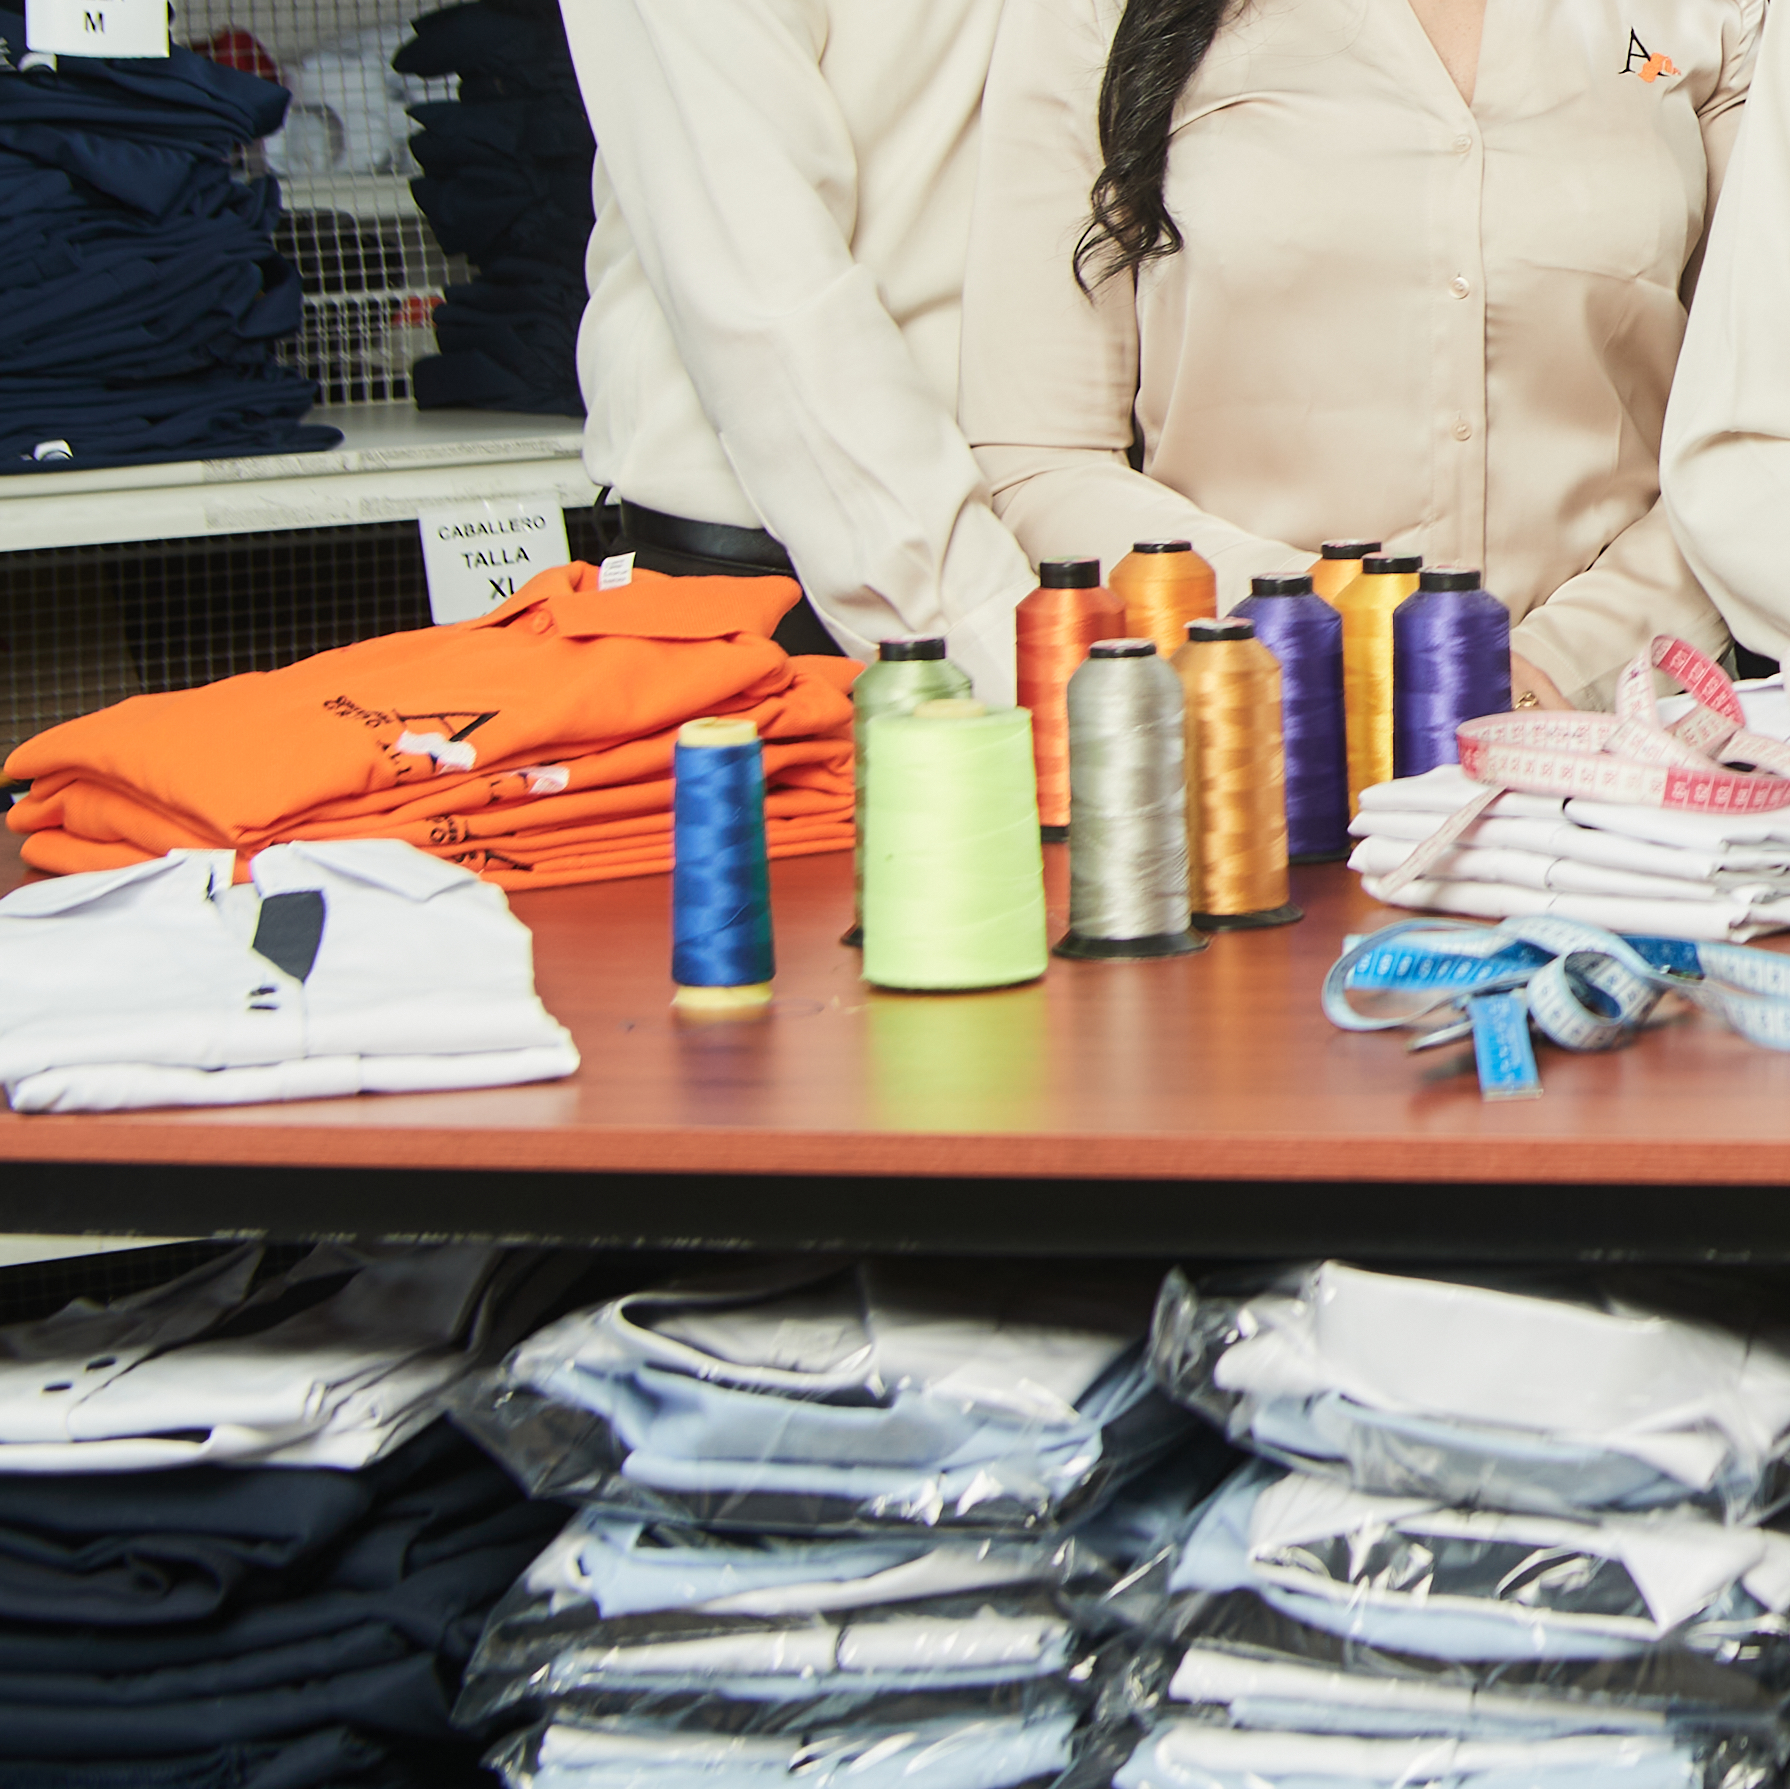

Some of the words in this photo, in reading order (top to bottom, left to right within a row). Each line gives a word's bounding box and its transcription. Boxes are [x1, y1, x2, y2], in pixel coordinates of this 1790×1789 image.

[83, 10, 105, 34] M
[1618, 26, 1669, 77] A
[438, 515, 547, 541] CABALLERO
[461, 546, 531, 570] TALLA
